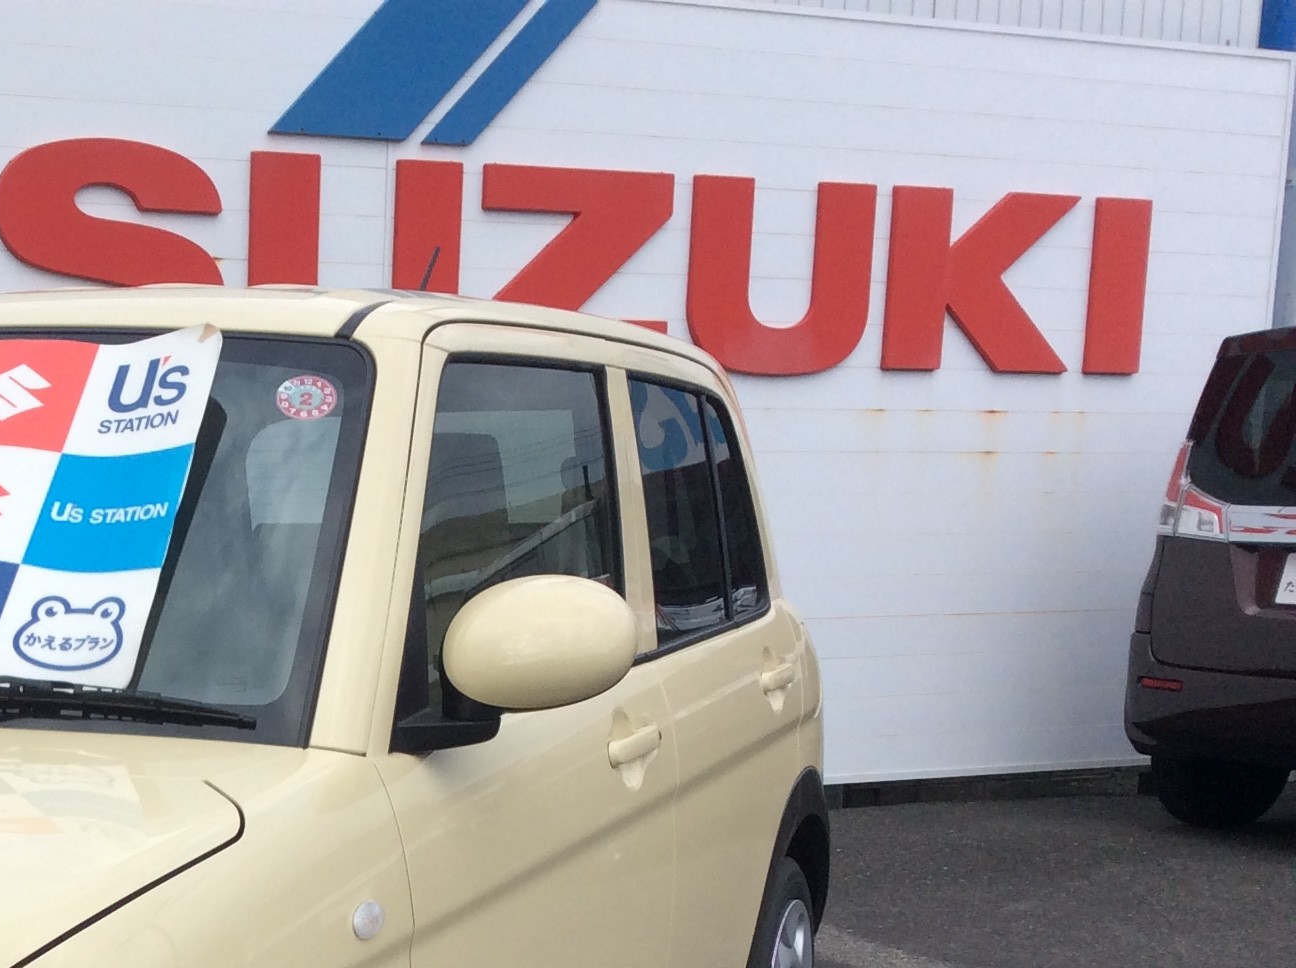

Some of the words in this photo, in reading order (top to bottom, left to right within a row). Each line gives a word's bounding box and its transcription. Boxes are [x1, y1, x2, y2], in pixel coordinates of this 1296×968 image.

[107, 355, 190, 414] U's
[300, 392, 312, 406] 2
[97, 410, 180, 434] STATION
[89, 502, 169, 525] STATION
[23, 632, 115, 652] かえるプラン
